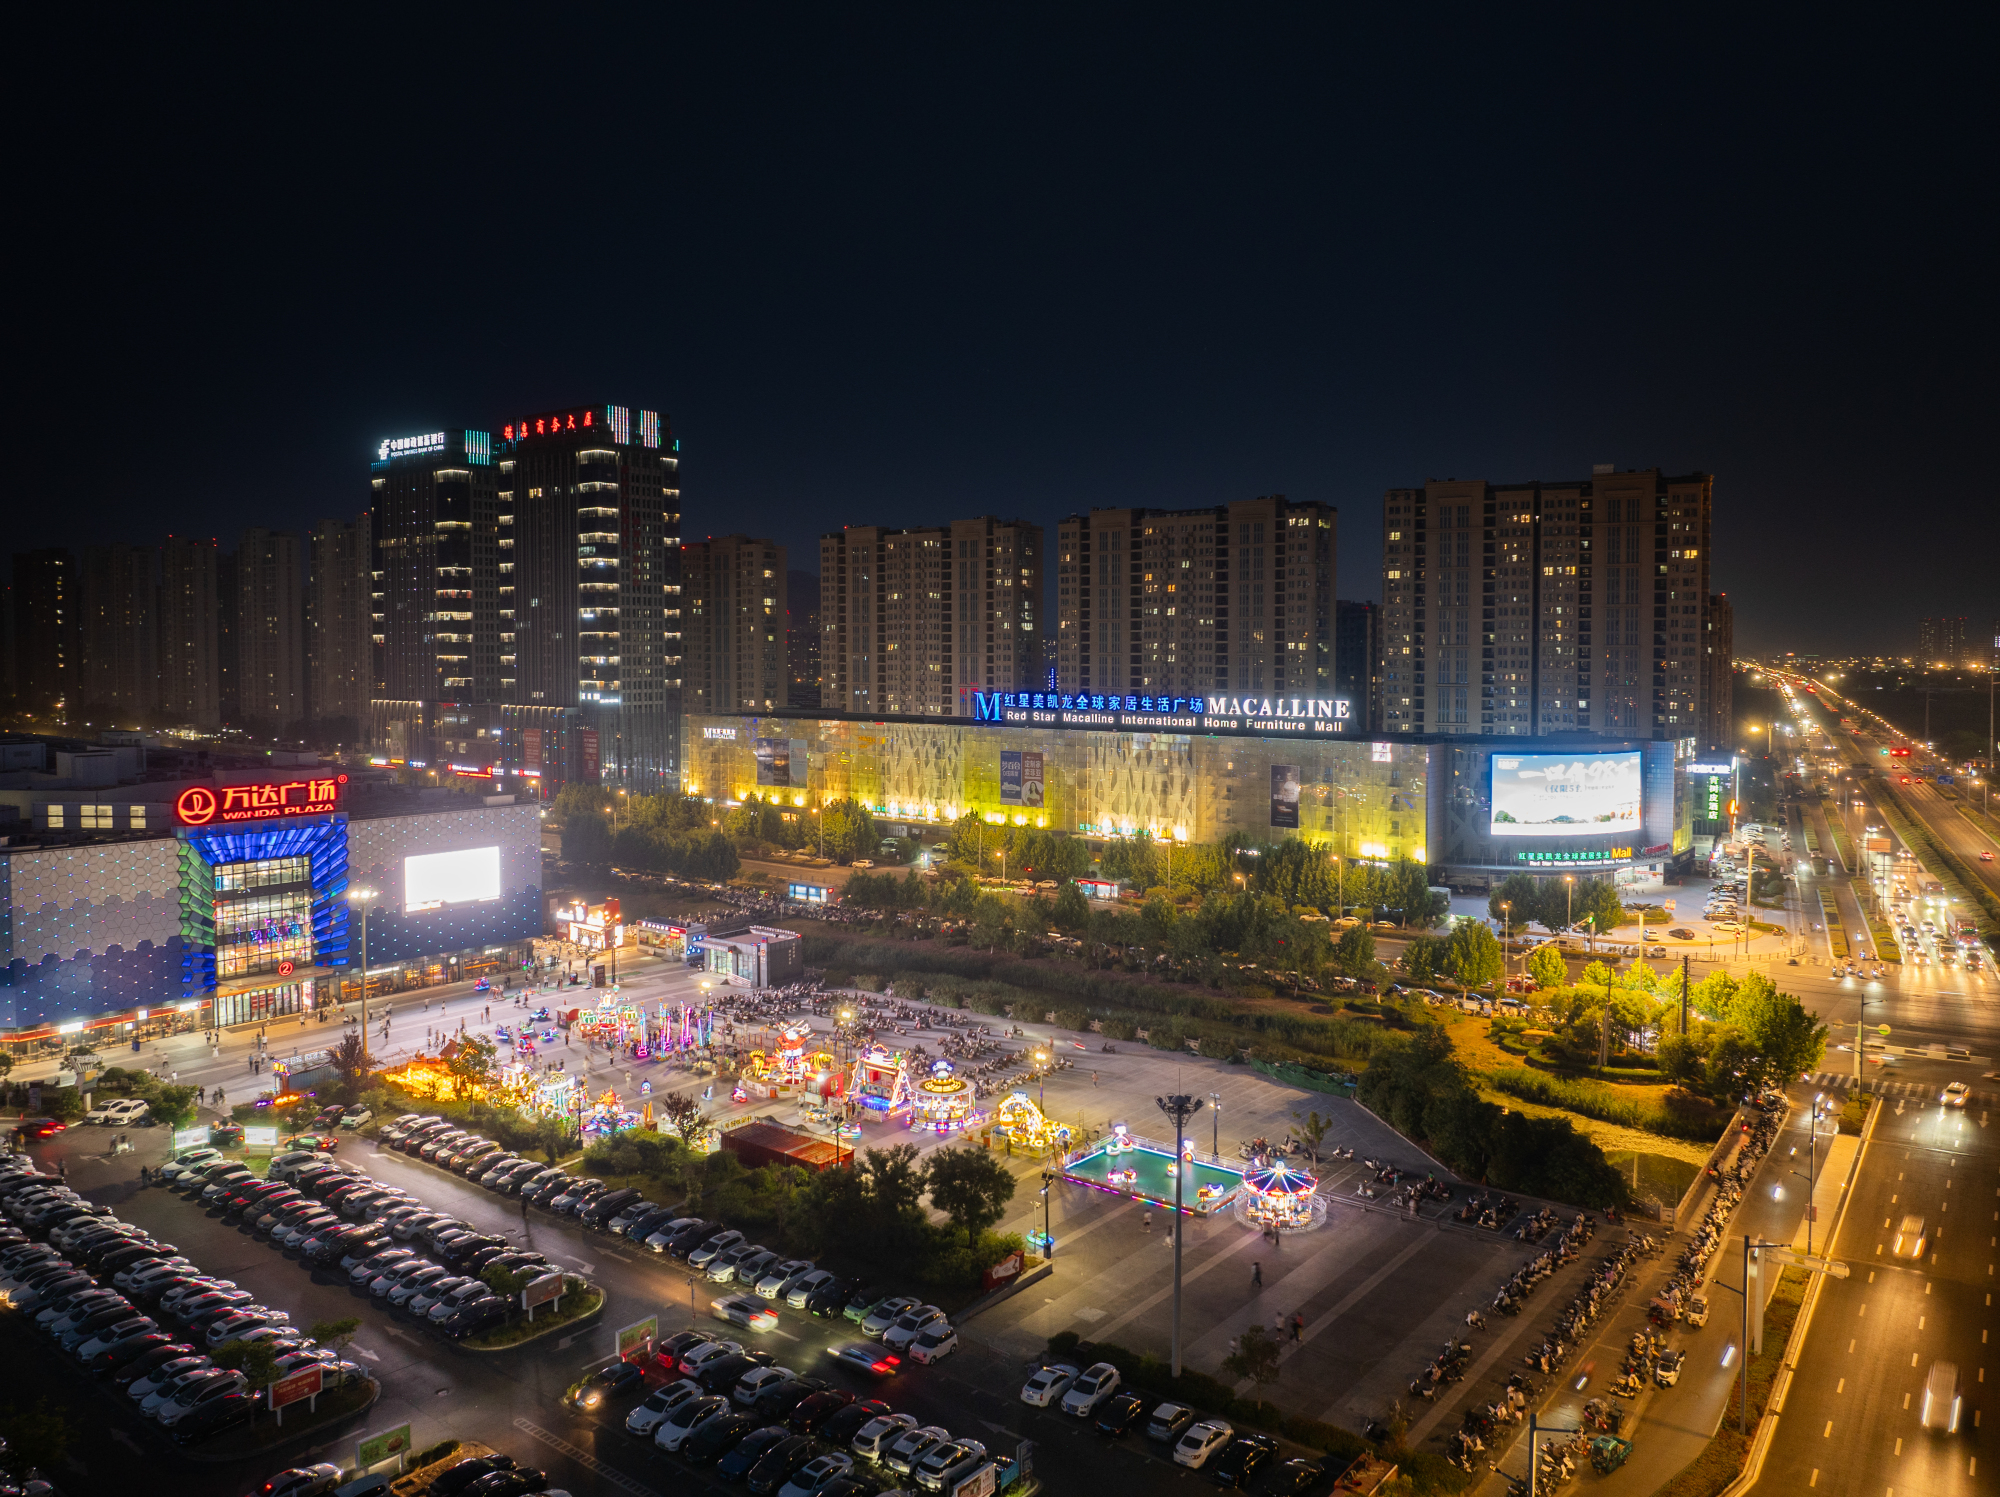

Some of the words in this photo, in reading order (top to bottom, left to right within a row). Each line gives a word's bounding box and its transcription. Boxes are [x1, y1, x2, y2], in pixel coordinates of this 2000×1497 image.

[973, 691, 1003, 721] M
[1004, 693, 1204, 714] 红星美凯龙全球家居生活广场
[1207, 697, 1350, 719] MACALLINE
[1007, 711, 1026, 721] Red
[1033, 712, 1056, 722] Star
[1063, 712, 1114, 724] Macalline
[1121, 714, 1197, 727] International
[1204, 717, 1238, 729] Home
[1246, 718, 1306, 731] Furniture
[1314, 720, 1343, 732] Mall
[221, 778, 336, 810] 万达广场
[222, 808, 281, 820] WANDA
[284, 803, 335, 815] PLAZA
[1611, 846, 1633, 859] Mall
